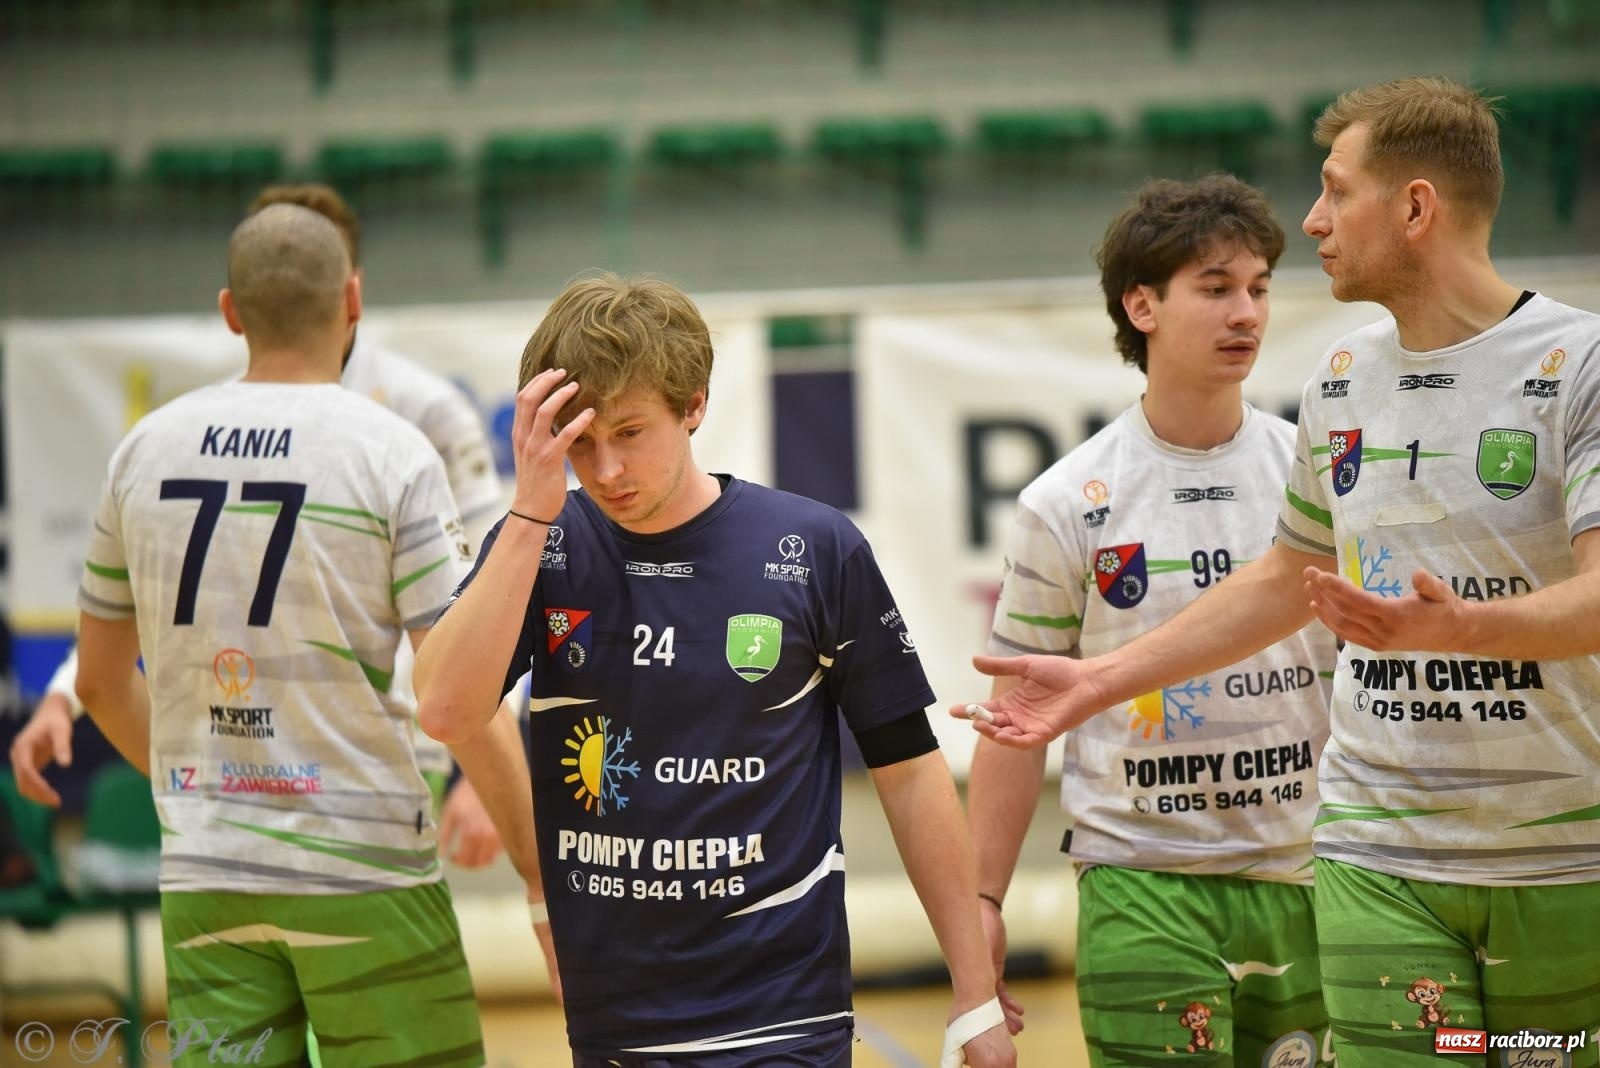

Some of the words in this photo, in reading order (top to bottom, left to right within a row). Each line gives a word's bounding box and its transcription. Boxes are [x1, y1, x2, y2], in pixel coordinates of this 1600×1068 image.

[1330, 379, 1351, 390] SPORT
[1523, 379, 1537, 390] MK
[1537, 379, 1561, 391] SPORT
[200, 425, 292, 458] KANIA
[1484, 432, 1532, 446] OLIMPIA
[1406, 439, 1420, 481] 1
[158, 478, 307, 627] 77
[764, 562, 780, 574] MK
[780, 564, 811, 578] SPORT
[764, 572, 809, 586] FOUNDATION
[1191, 548, 1232, 589] 99
[731, 617, 780, 630] OLIMPIA
[632, 623, 676, 667] 24
[1224, 665, 1315, 699] GUARD
[1425, 659, 1545, 691] CIEPŁA
[226, 707, 273, 726] SPORT
[1371, 699, 1405, 722] 05
[1410, 701, 1462, 722] 944
[1471, 700, 1526, 722] 146
[211, 724, 275, 739] FOUNDATION
[221, 762, 321, 779] KULTURALNE
[654, 756, 766, 784] GUARD
[1123, 753, 1225, 788] POMPY
[1233, 739, 1313, 781] CIEPŁA
[220, 776, 323, 795] ZAWIERCIE
[1157, 793, 1207, 814] 605
[1215, 788, 1263, 810] 944
[1270, 781, 1303, 804] 146
[558, 829, 645, 870] POMPY
[652, 833, 765, 871] CIEPŁA
[588, 874, 625, 898] 605
[632, 879, 683, 901] 944
[692, 875, 745, 900] 146
